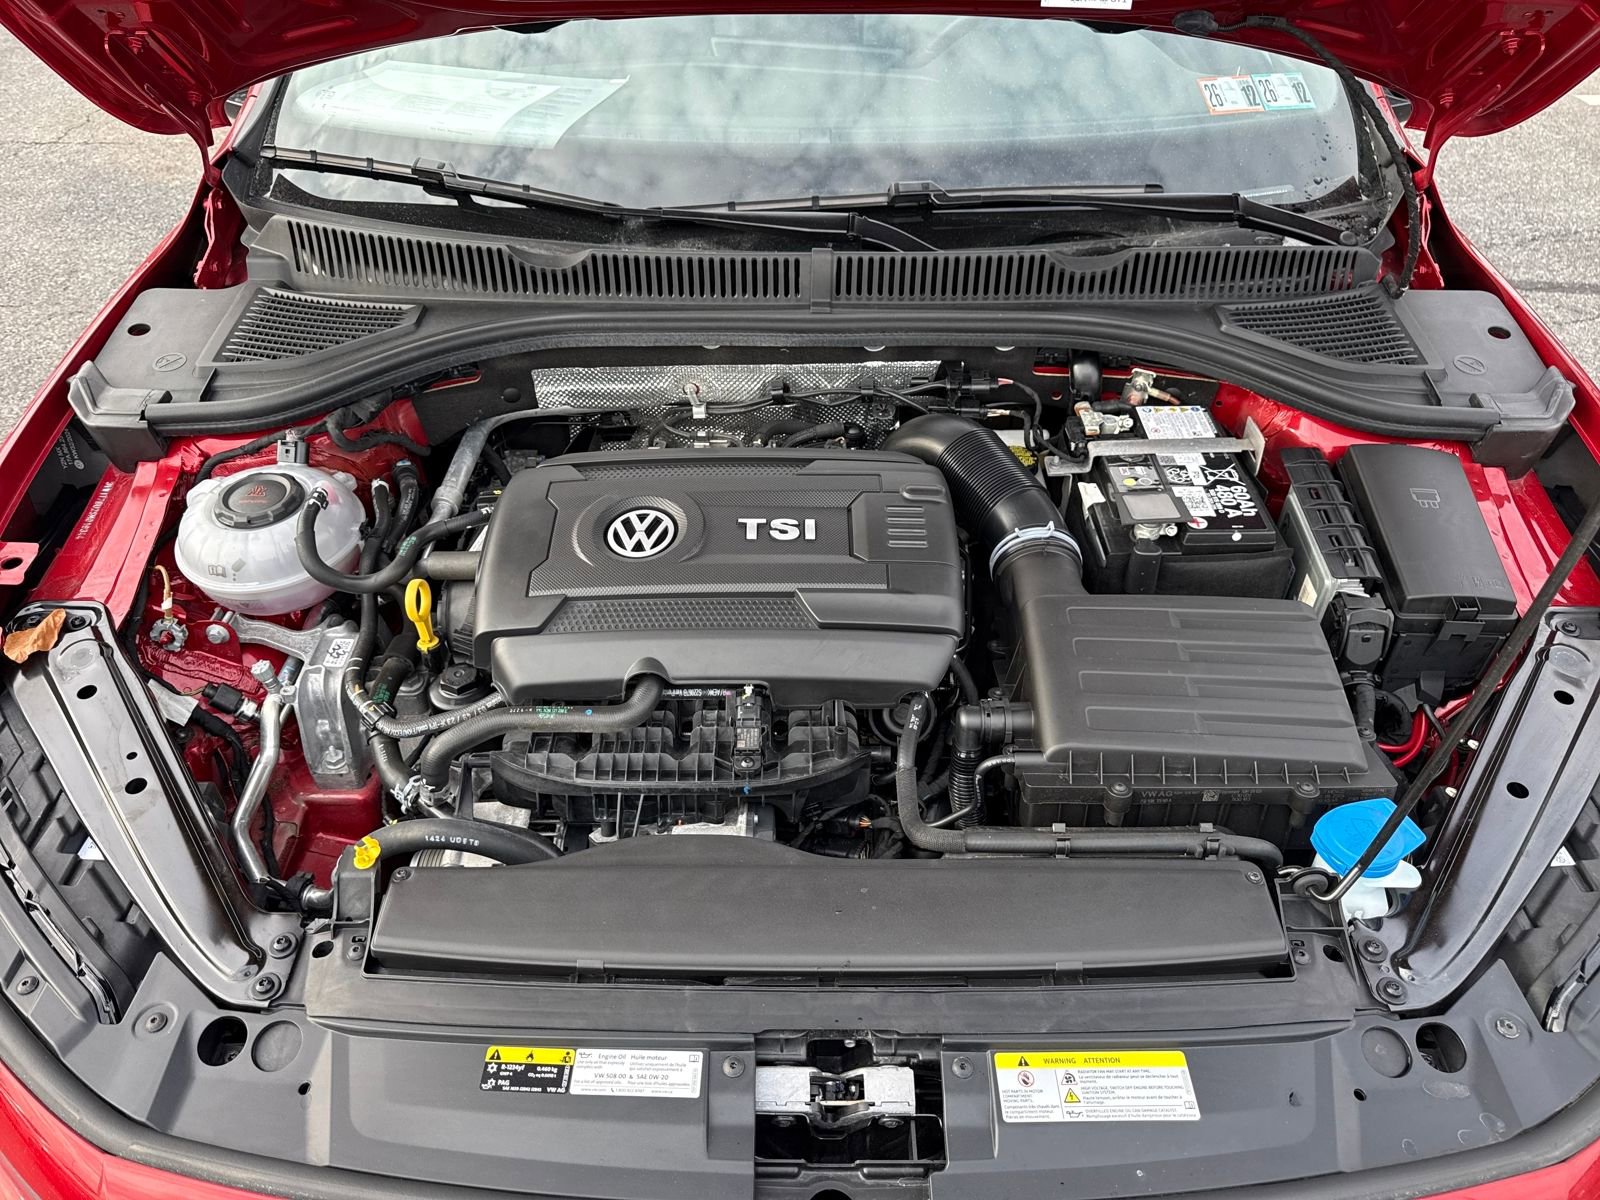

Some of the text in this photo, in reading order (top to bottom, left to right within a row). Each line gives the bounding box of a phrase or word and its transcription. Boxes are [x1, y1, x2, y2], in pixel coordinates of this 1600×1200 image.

[1204, 84, 1224, 107] 26
[1241, 85, 1260, 106] 12
[1259, 79, 1277, 102] 26
[1292, 82, 1310, 103] 12
[1215, 485, 1237, 506] 480
[1230, 486, 1258, 516] 60Ah
[1224, 508, 1243, 518] A
[737, 518, 816, 541] TSI
